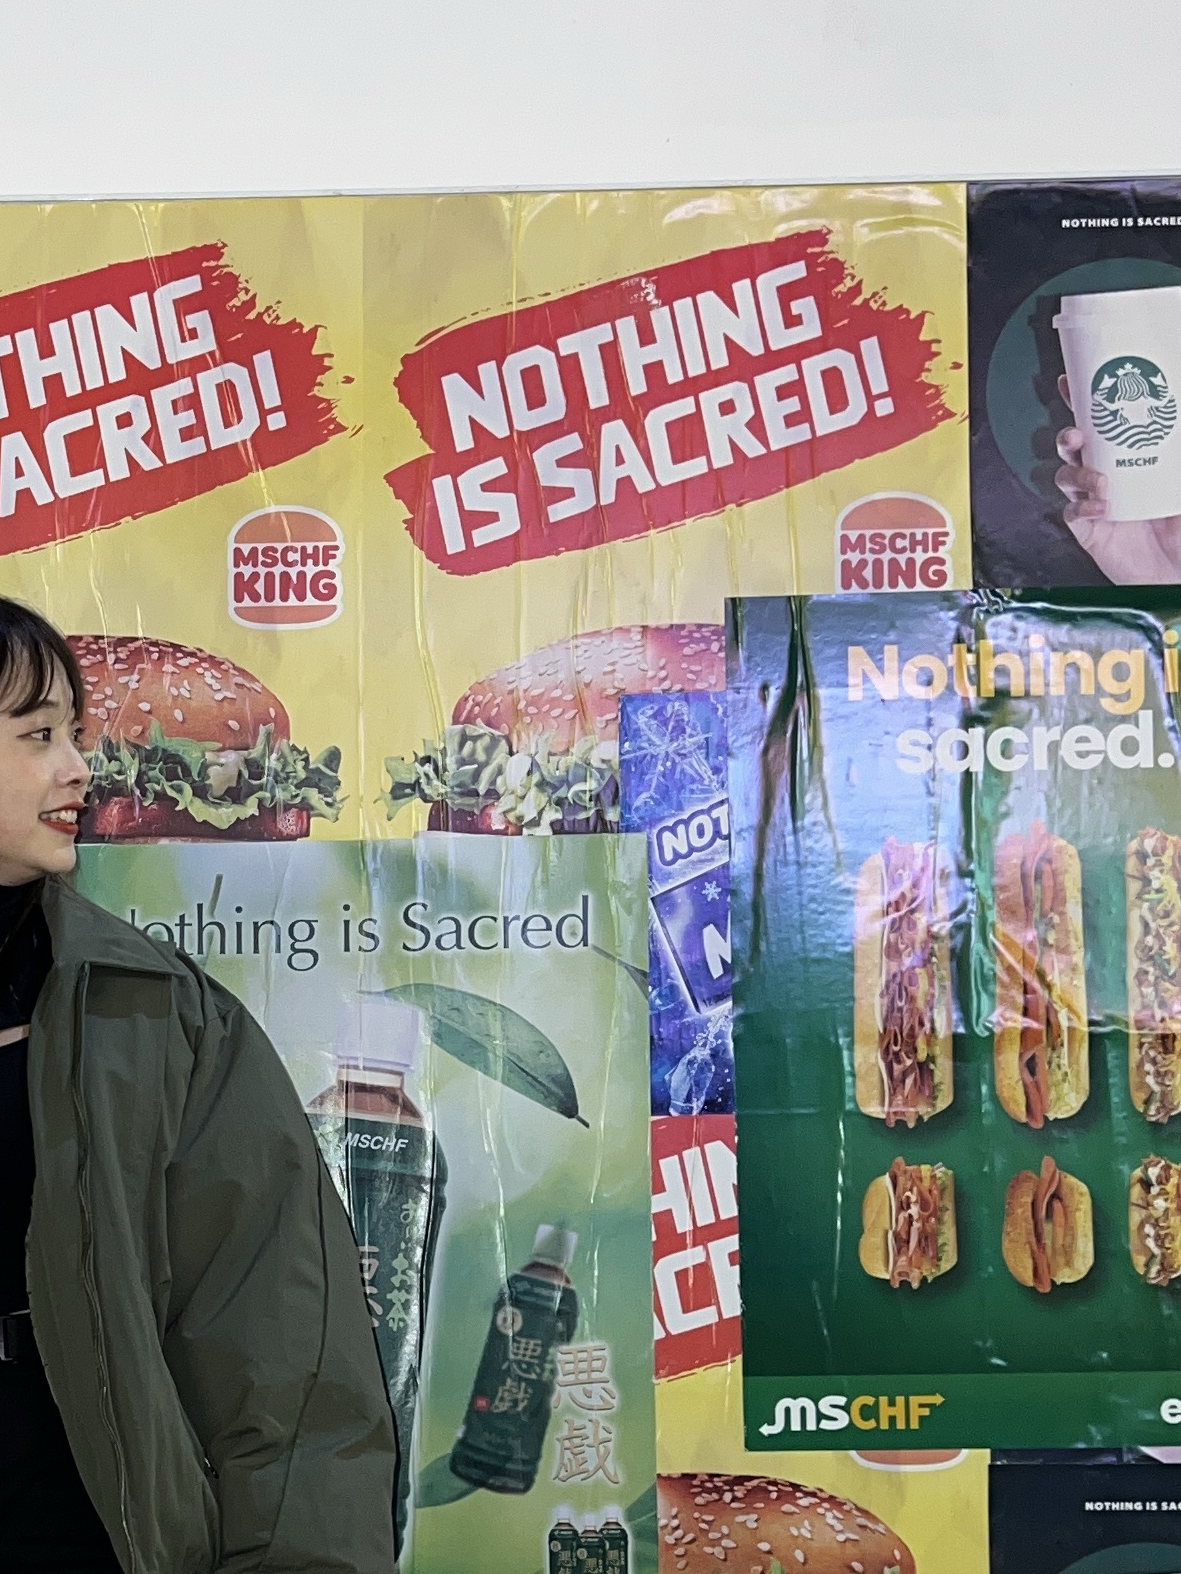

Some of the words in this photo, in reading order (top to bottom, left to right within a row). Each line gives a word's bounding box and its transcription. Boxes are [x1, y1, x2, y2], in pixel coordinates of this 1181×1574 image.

[1061, 217, 1119, 228] NOTHING
[1122, 217, 1134, 227] IS
[442, 261, 823, 452] NOTHING
[433, 457, 520, 554] IS
[533, 336, 895, 522] SACRED!
[1116, 456, 1159, 468] MSCHF
[233, 545, 340, 568] MSCHF
[840, 531, 950, 555] MSCHF
[233, 570, 338, 603] KING
[840, 556, 948, 590] KING
[847, 634, 1146, 715] Nothing
[895, 709, 1175, 775] sacred.
[130, 903, 319, 972] othing
[342, 903, 381, 954] is
[401, 895, 590, 953] Sacred
[345, 1132, 409, 1153] MSCHF
[759, 1393, 946, 1438] MSCHF
[1085, 1501, 1143, 1511] NOTHING
[1145, 1501, 1158, 1511] IS
